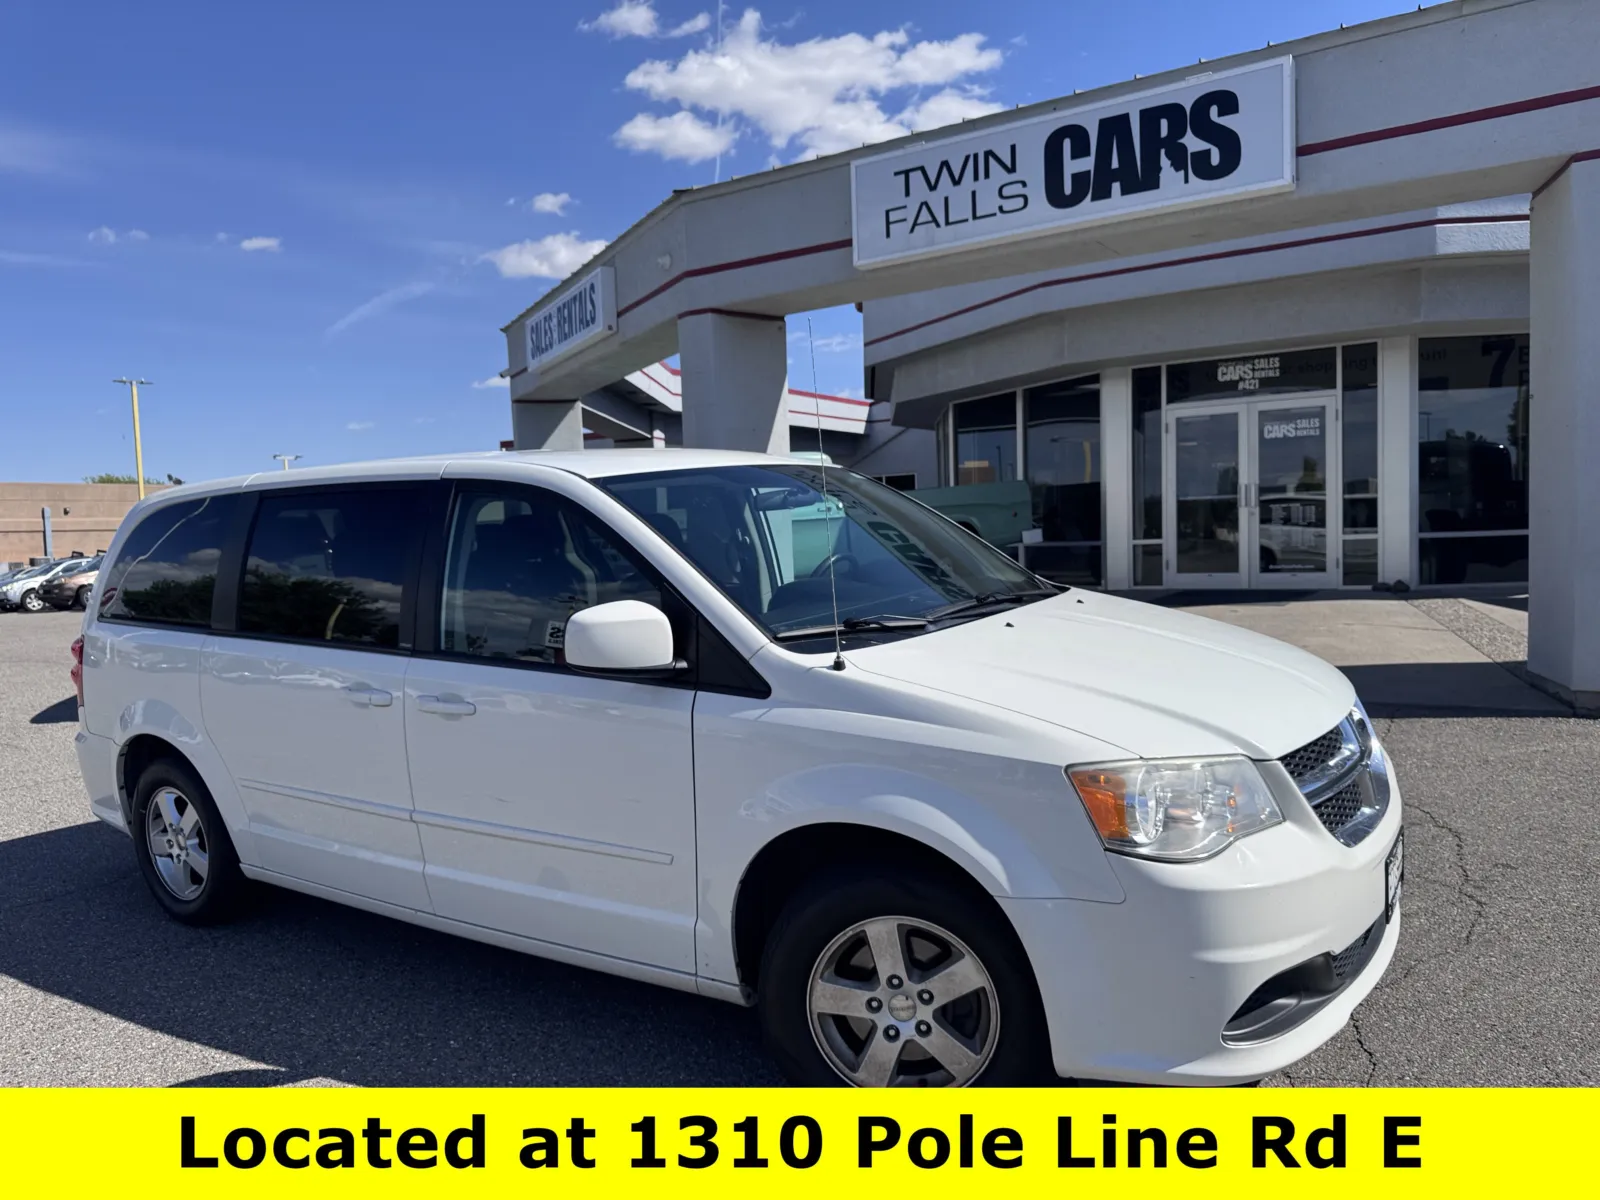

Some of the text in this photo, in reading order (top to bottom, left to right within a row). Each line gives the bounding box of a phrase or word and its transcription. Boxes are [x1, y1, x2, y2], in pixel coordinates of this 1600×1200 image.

[893, 143, 1018, 198] TWIN
[1043, 88, 1242, 210] CARS
[884, 179, 1029, 239] FALLS
[530, 282, 597, 361] SALES RENTALS
[1217, 364, 1254, 382] CARS
[1253, 356, 1280, 369] SALES
[1238, 379, 1259, 391] #421
[1263, 417, 1320, 439] CARS SALES
